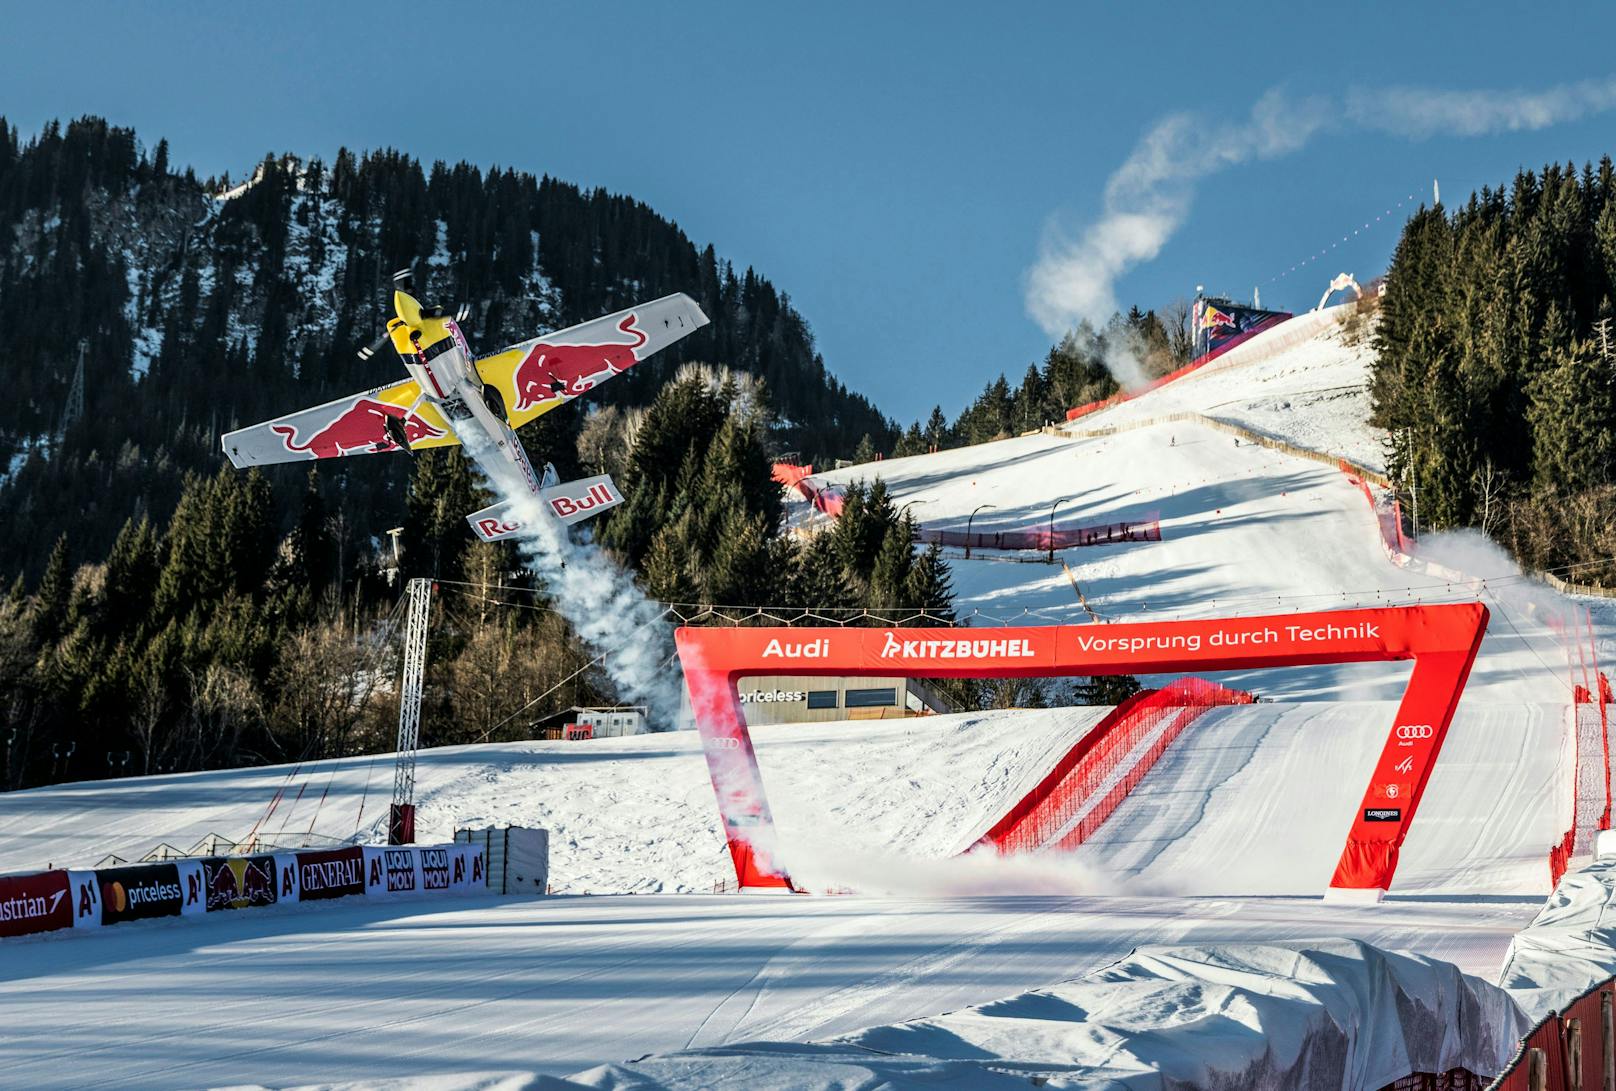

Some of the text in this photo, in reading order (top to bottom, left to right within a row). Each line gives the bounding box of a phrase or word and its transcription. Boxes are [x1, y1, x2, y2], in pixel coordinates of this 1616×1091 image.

[477, 483, 615, 538] Re Bull
[761, 638, 830, 659] Audi
[1077, 621, 1380, 653] Vorsprung durch Technik
[301, 858, 363, 891] GENERALI
[370, 854, 383, 887] A1
[386, 851, 413, 870] LIQUI
[421, 850, 447, 868] LIQUI
[453, 853, 465, 884] A1
[472, 852, 484, 882] A1
[186, 869, 202, 906] A1
[282, 863, 295, 897] A1
[388, 870, 414, 890] MOLY
[423, 869, 449, 889] MOLY
[79, 879, 97, 918] A1
[128, 881, 182, 910] priceless
